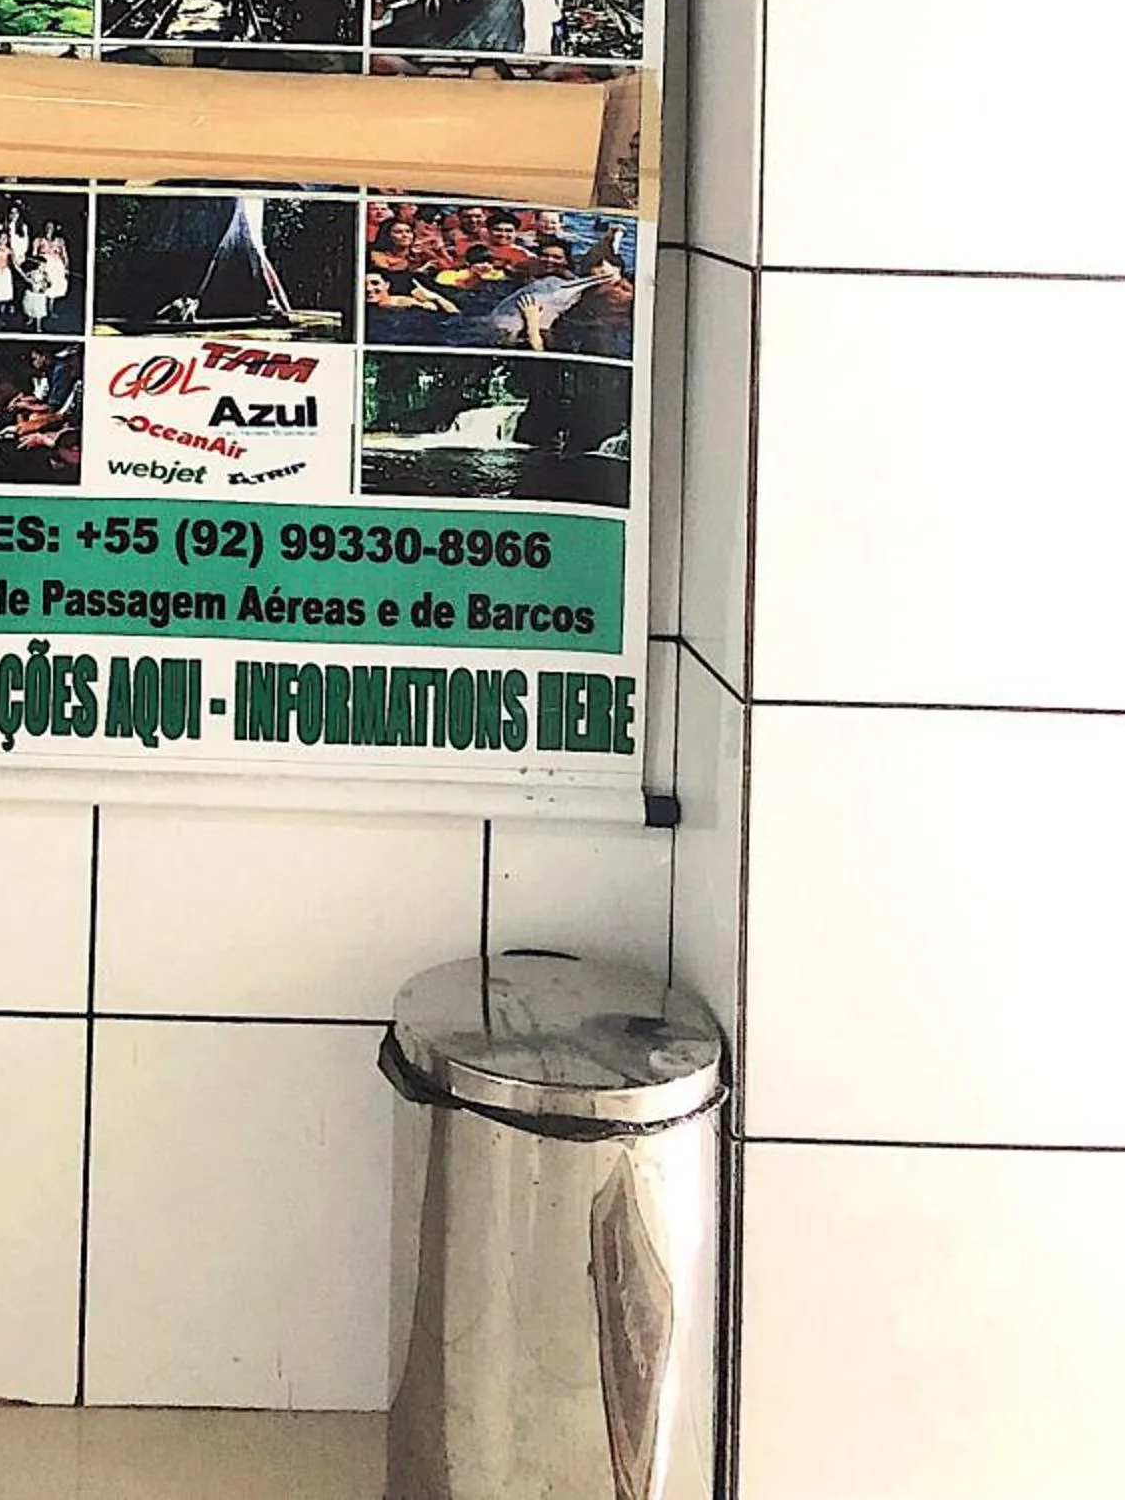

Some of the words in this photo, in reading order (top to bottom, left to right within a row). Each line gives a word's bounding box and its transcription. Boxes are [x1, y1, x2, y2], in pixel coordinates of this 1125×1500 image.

[108, 355, 212, 399] GOL
[202, 342, 320, 383] TAM
[208, 396, 318, 428] Azul
[127, 414, 249, 460] OceanAir
[107, 459, 208, 485] webjet
[77, 516, 160, 555] +55
[175, 517, 264, 568] (92)
[280, 523, 552, 569] 99330-8966
[42, 579, 226, 628] Passagem
[237, 584, 367, 626] Aéreas
[377, 598, 401, 627] e
[410, 591, 456, 630] de
[467, 592, 596, 635] Barcos
[105, 655, 203, 749] AQUI
[234, 660, 529, 753] INFORMATIONS
[536, 670, 637, 756] HERE
